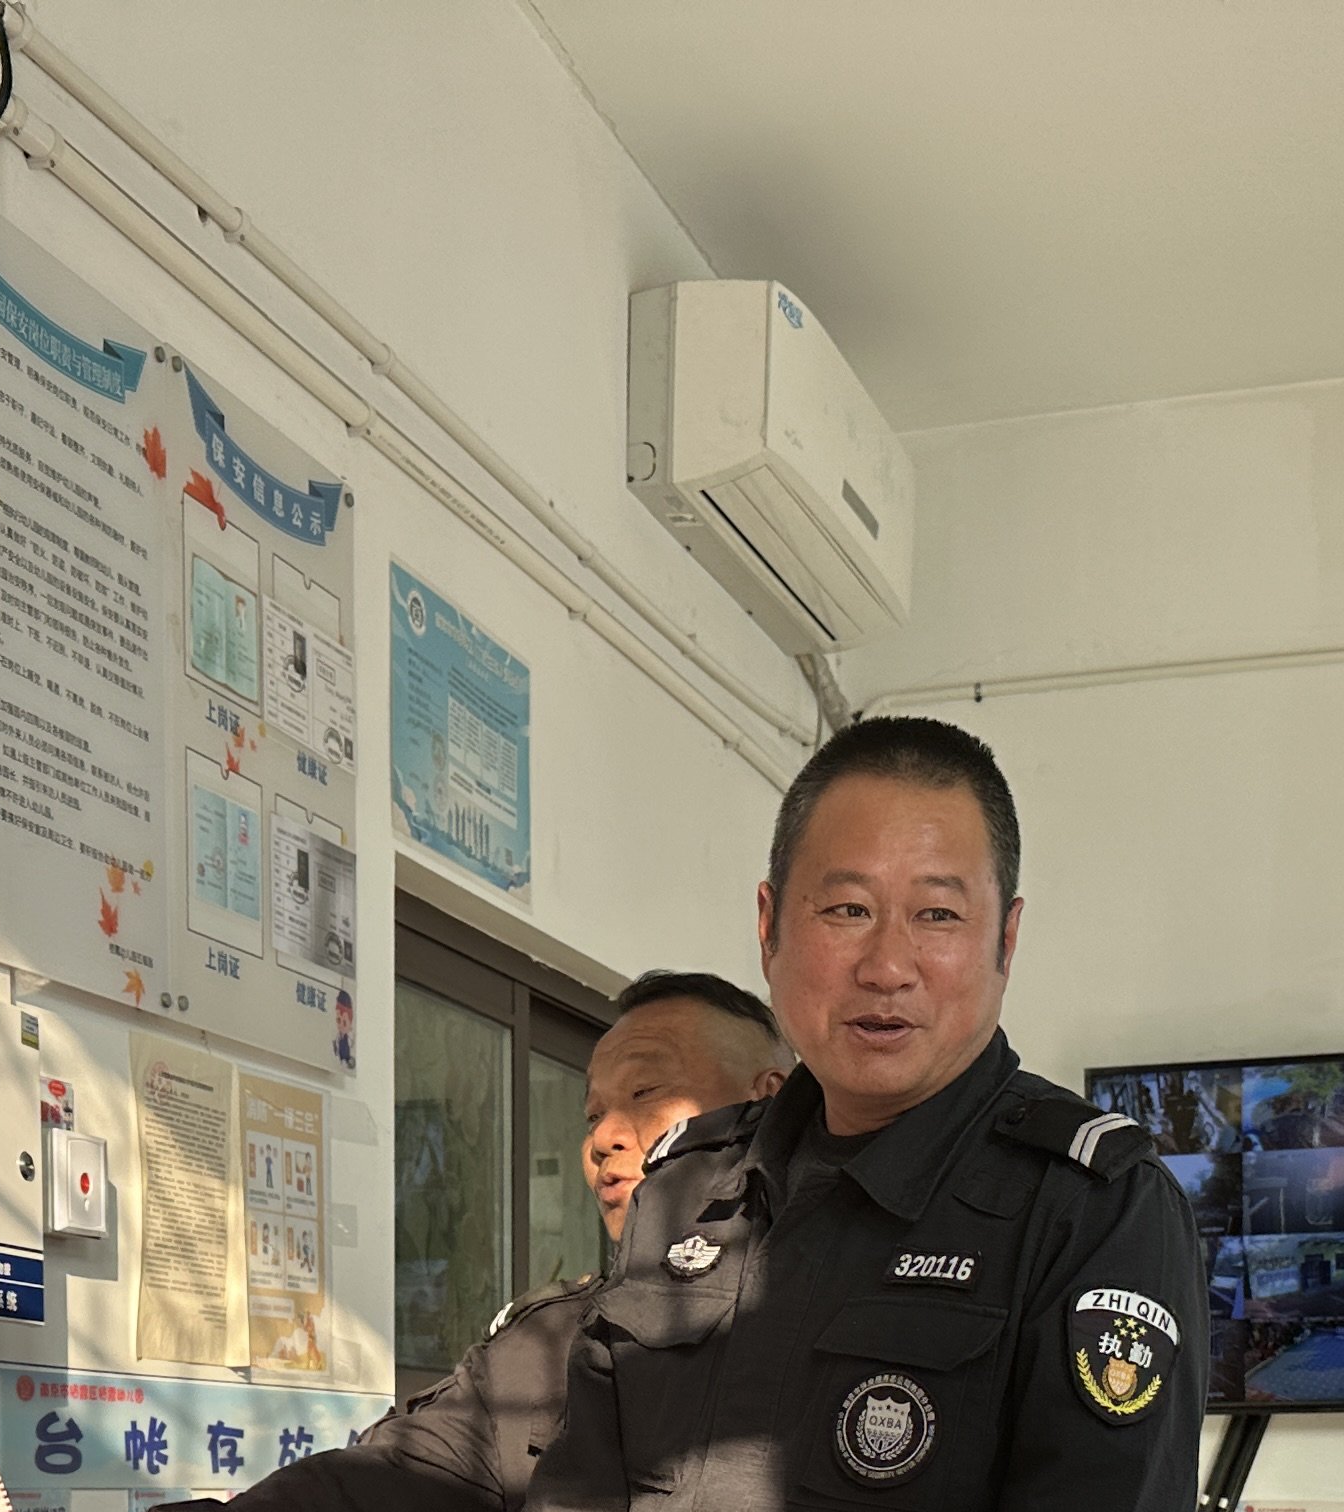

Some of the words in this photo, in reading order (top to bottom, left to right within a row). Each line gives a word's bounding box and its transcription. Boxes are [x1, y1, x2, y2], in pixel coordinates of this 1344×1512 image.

[212, 433, 322, 536] 保安信息公示
[205, 699, 241, 737] 上岗证
[296, 750, 329, 787] 健康证
[205, 945, 241, 981] 上岗证
[295, 980, 328, 1013] 健康证
[894, 1252, 975, 1282] 320116
[1092, 1291, 1131, 1312] ZHI
[1137, 1301, 1172, 1332] QIN
[1098, 1331, 1153, 1369] 执勤
[35, 1409, 364, 1475] 台帐存放
